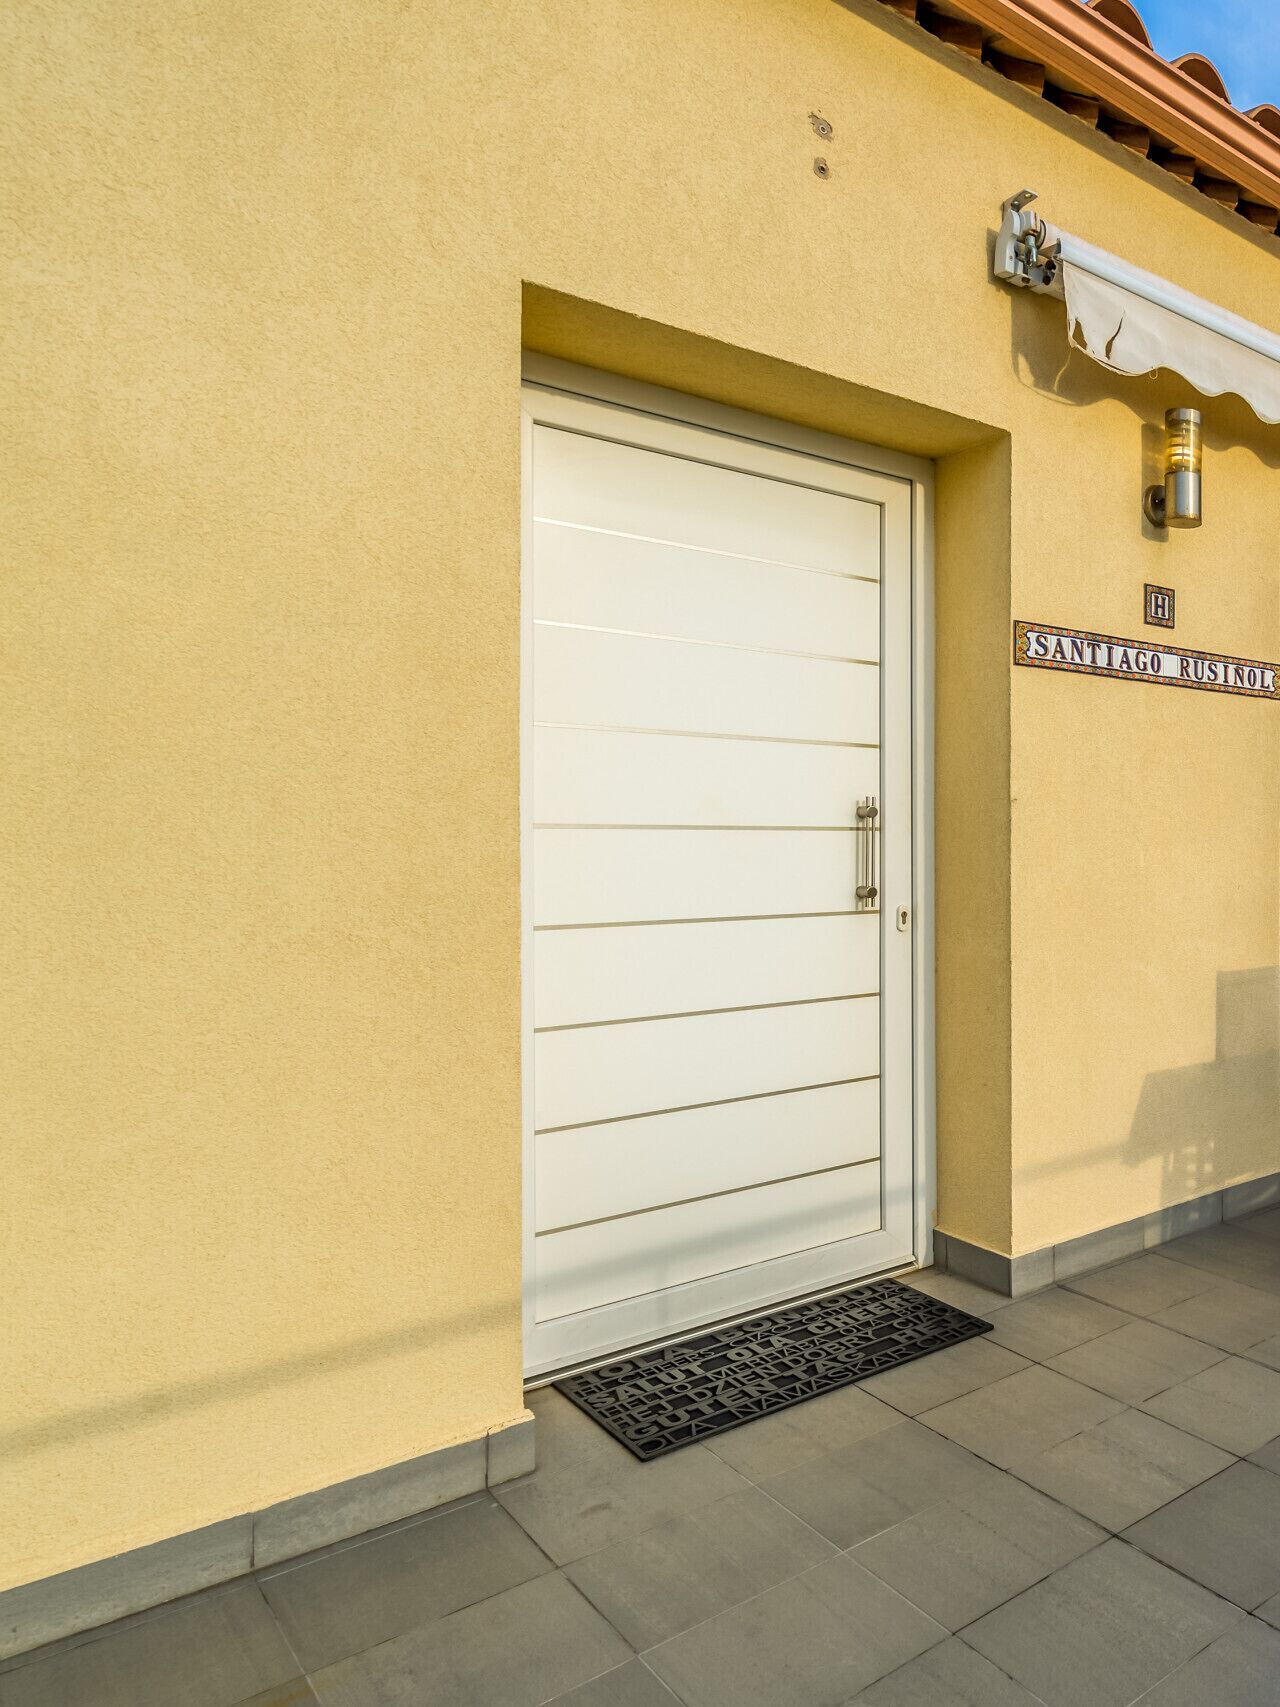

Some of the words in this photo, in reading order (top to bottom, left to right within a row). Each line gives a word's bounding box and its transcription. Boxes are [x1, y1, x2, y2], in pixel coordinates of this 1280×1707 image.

[1153, 594, 1167, 618] H
[1034, 634, 1161, 675] SANTIAGO
[1179, 657, 1270, 690] RUSIÑOL
[558, 1343, 694, 1390] HOLA
[710, 1280, 902, 1342] BONJOUR
[575, 1382, 609, 1396] HI
[613, 1348, 718, 1384] CHEERS
[726, 1324, 795, 1348] CIAO
[800, 1299, 874, 1325] GUTEN
[582, 1360, 712, 1408] SALUT
[722, 1334, 796, 1362] OLA
[804, 1291, 929, 1335] CHEERS
[599, 1380, 695, 1417] HELLO
[704, 1335, 831, 1381] MERHABA
[837, 1317, 886, 1336] OLA
[604, 1399, 676, 1430] HEJ
[686, 1364, 781, 1401] DZIEN
[781, 1329, 883, 1368] DOBRY
[888, 1305, 956, 1330] CIAO
[620, 1379, 779, 1441] GUTEN
[781, 1348, 868, 1382] TAG
[888, 1313, 968, 1344] HEJ
[635, 1417, 718, 1453] OLA
[728, 1346, 916, 1418] NAMASKAR
